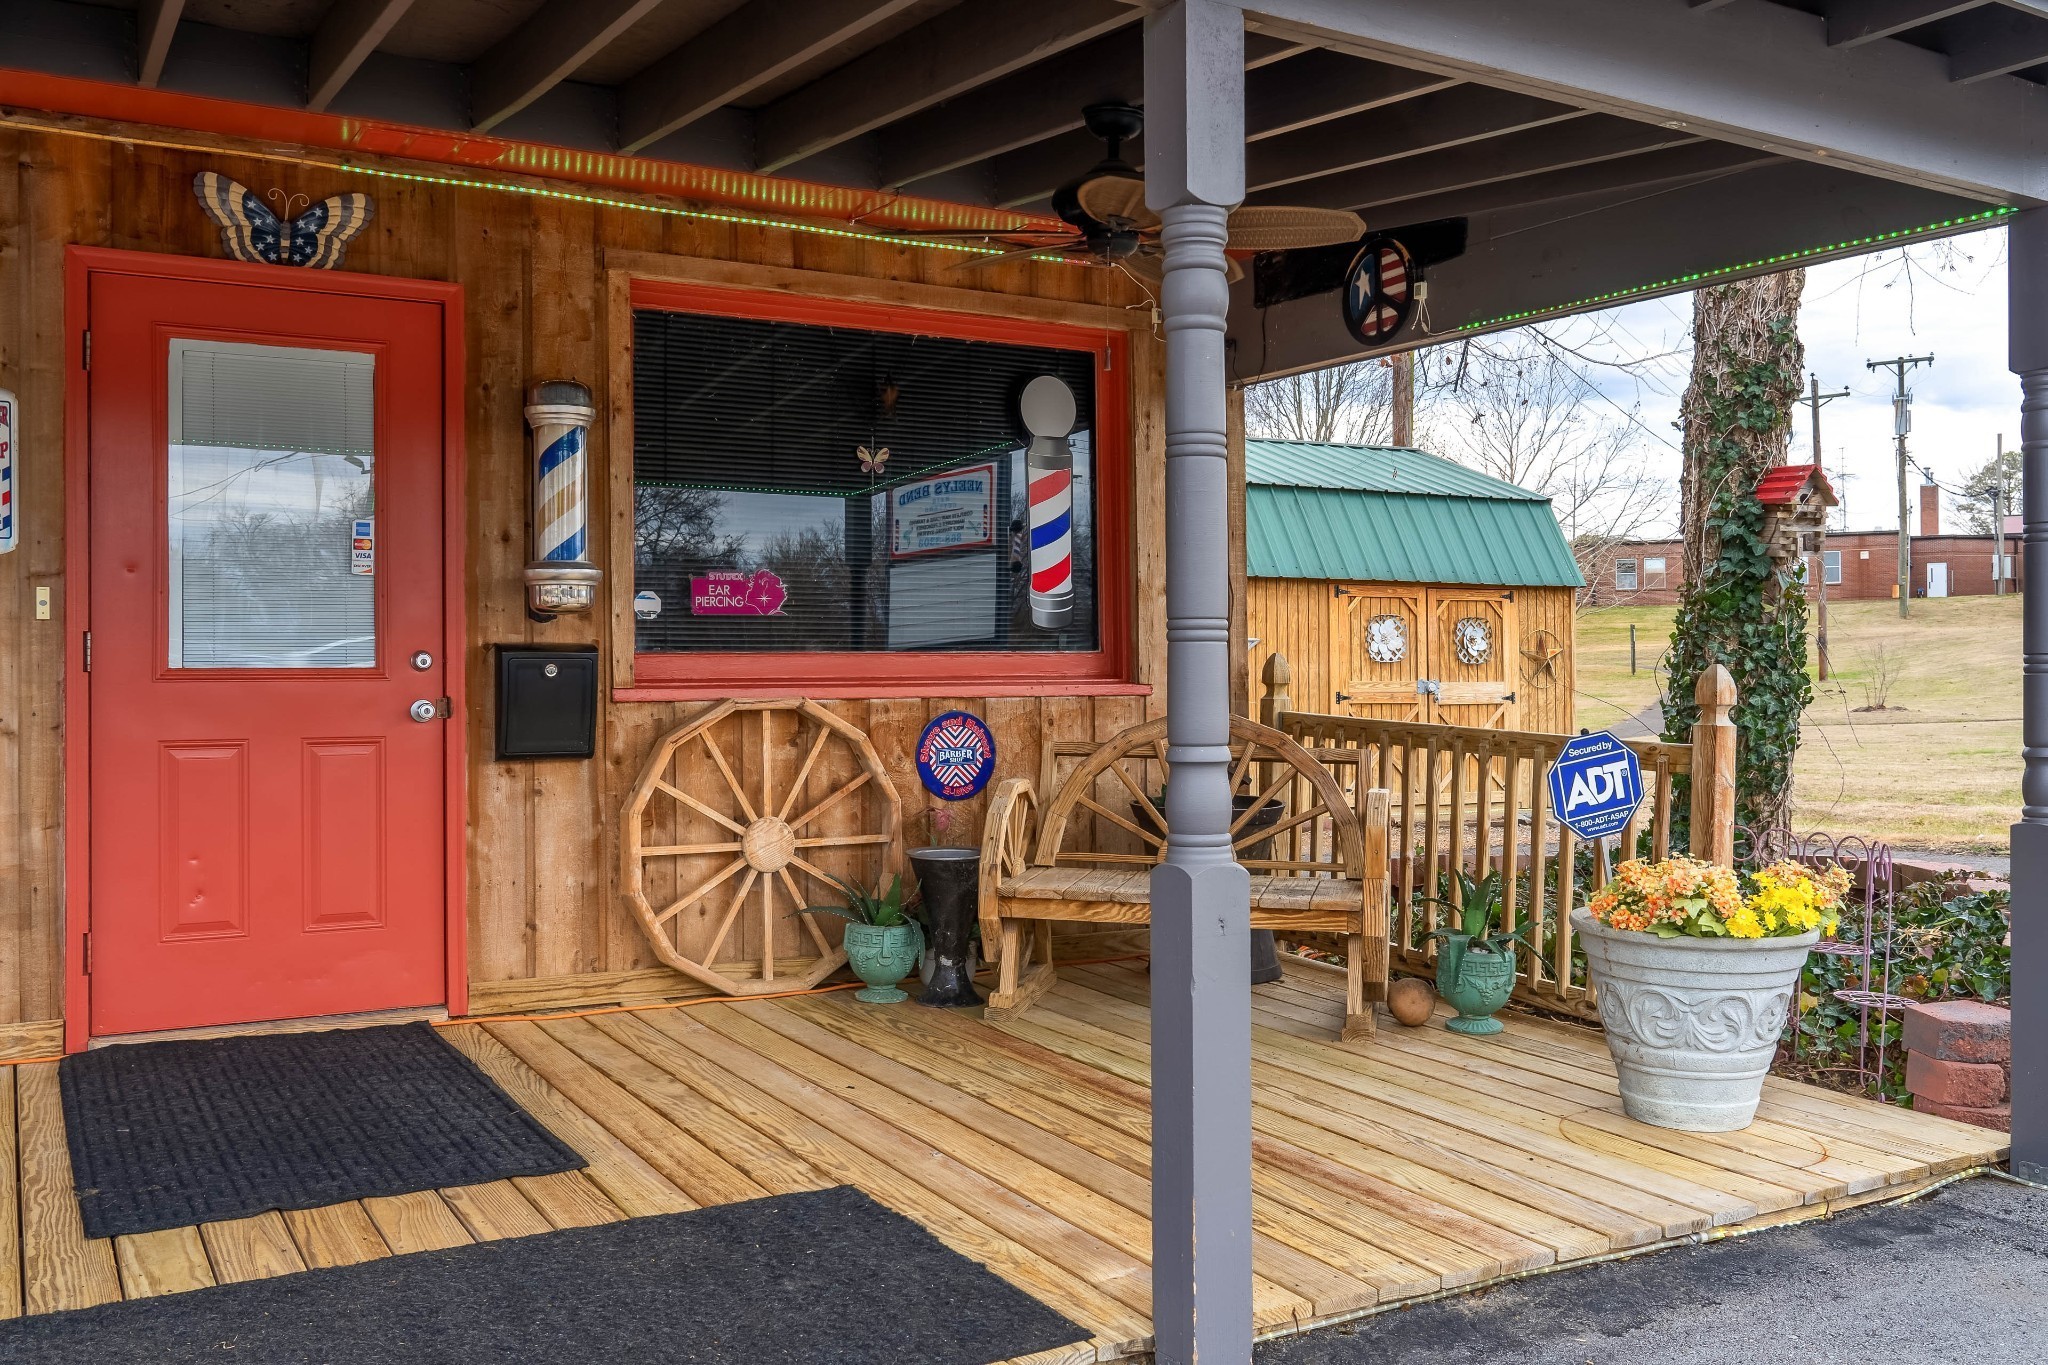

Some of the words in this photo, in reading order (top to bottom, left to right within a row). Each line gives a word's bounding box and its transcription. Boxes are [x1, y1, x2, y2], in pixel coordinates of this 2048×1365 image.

[708, 584, 731, 596] EAR
[695, 596, 744, 607] PIERCING
[941, 716, 963, 728] and
[939, 749, 973, 761] BARBER
[1568, 742, 1602, 757] Secured
[1602, 741, 1613, 751] by
[1567, 760, 1628, 811] ADT
[1574, 810, 1629, 829] 1-800-ADT-ASAP
